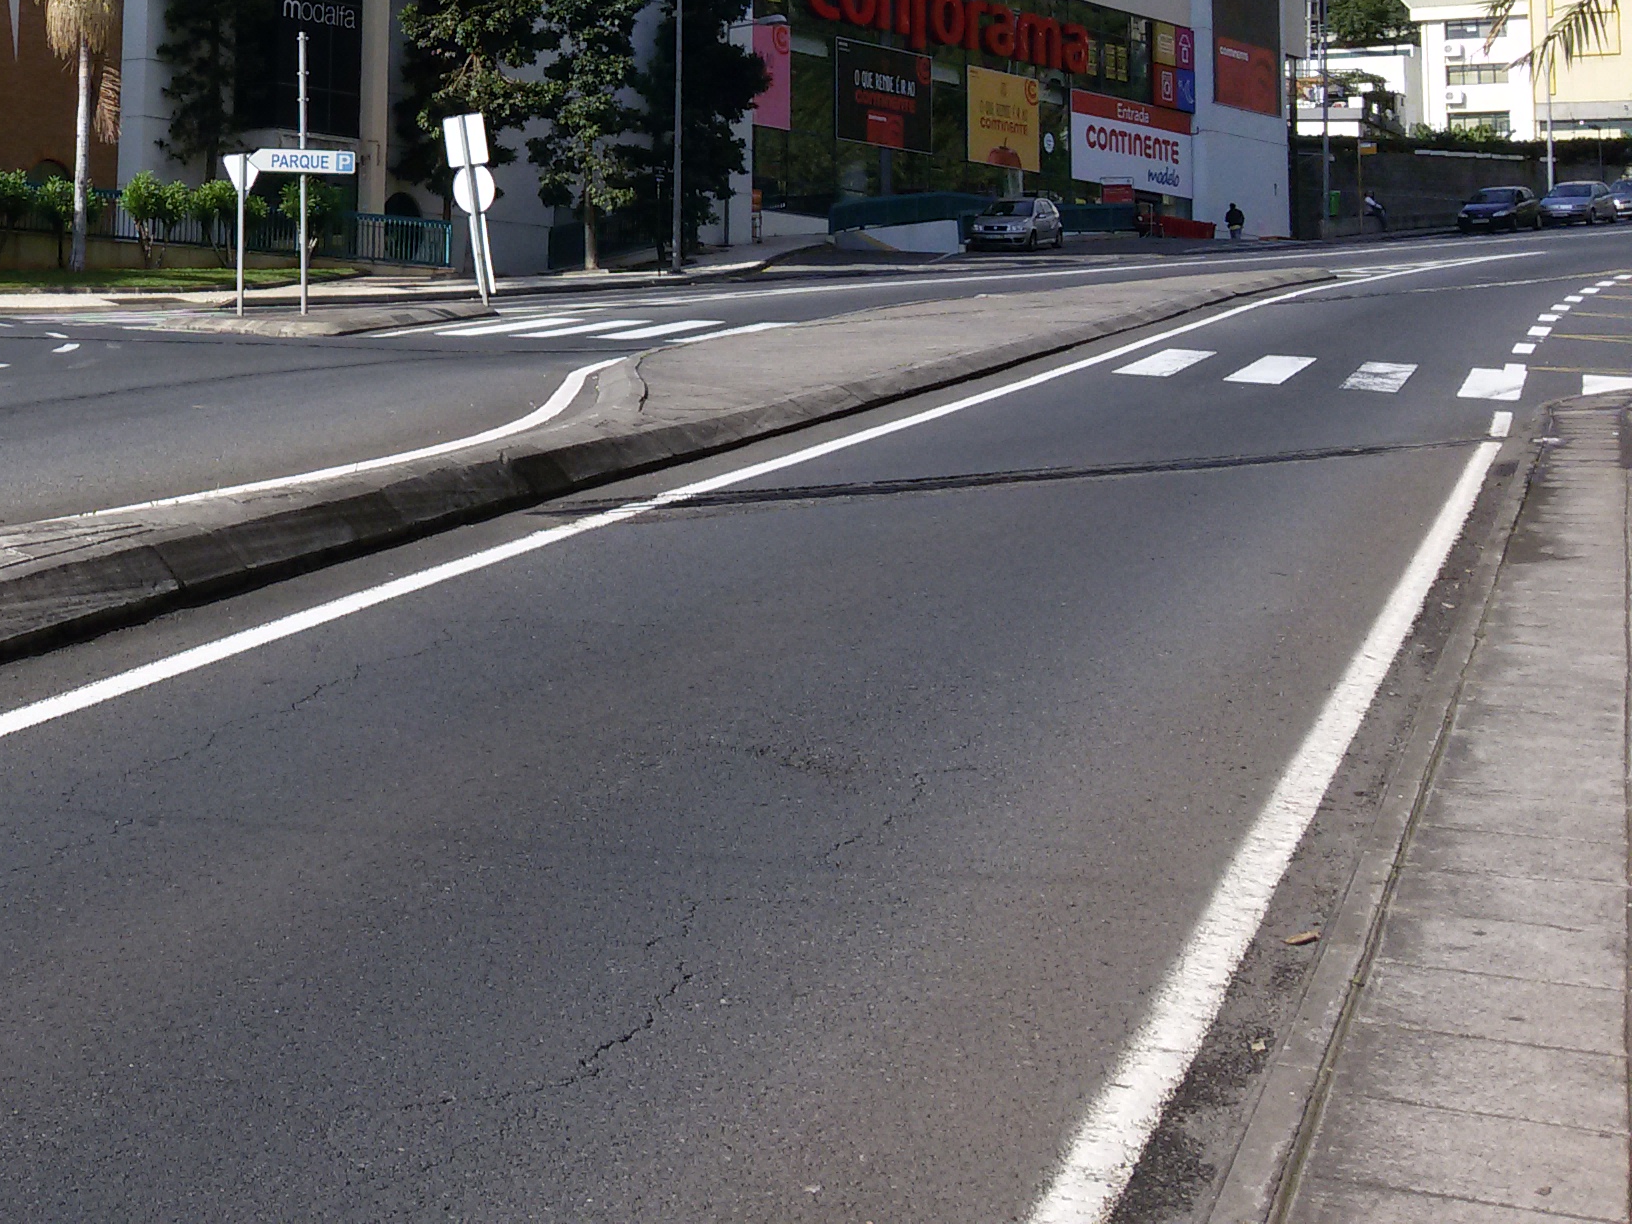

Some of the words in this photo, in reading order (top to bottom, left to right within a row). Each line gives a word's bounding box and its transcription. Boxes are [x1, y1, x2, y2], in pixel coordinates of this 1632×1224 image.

[1117, 103, 1150, 124] Entrada
[1085, 124, 1180, 165] CONTINENTE
[271, 153, 330, 169] PARQUE
[338, 155, 351, 170] P
[1147, 166, 1180, 187] modelo
